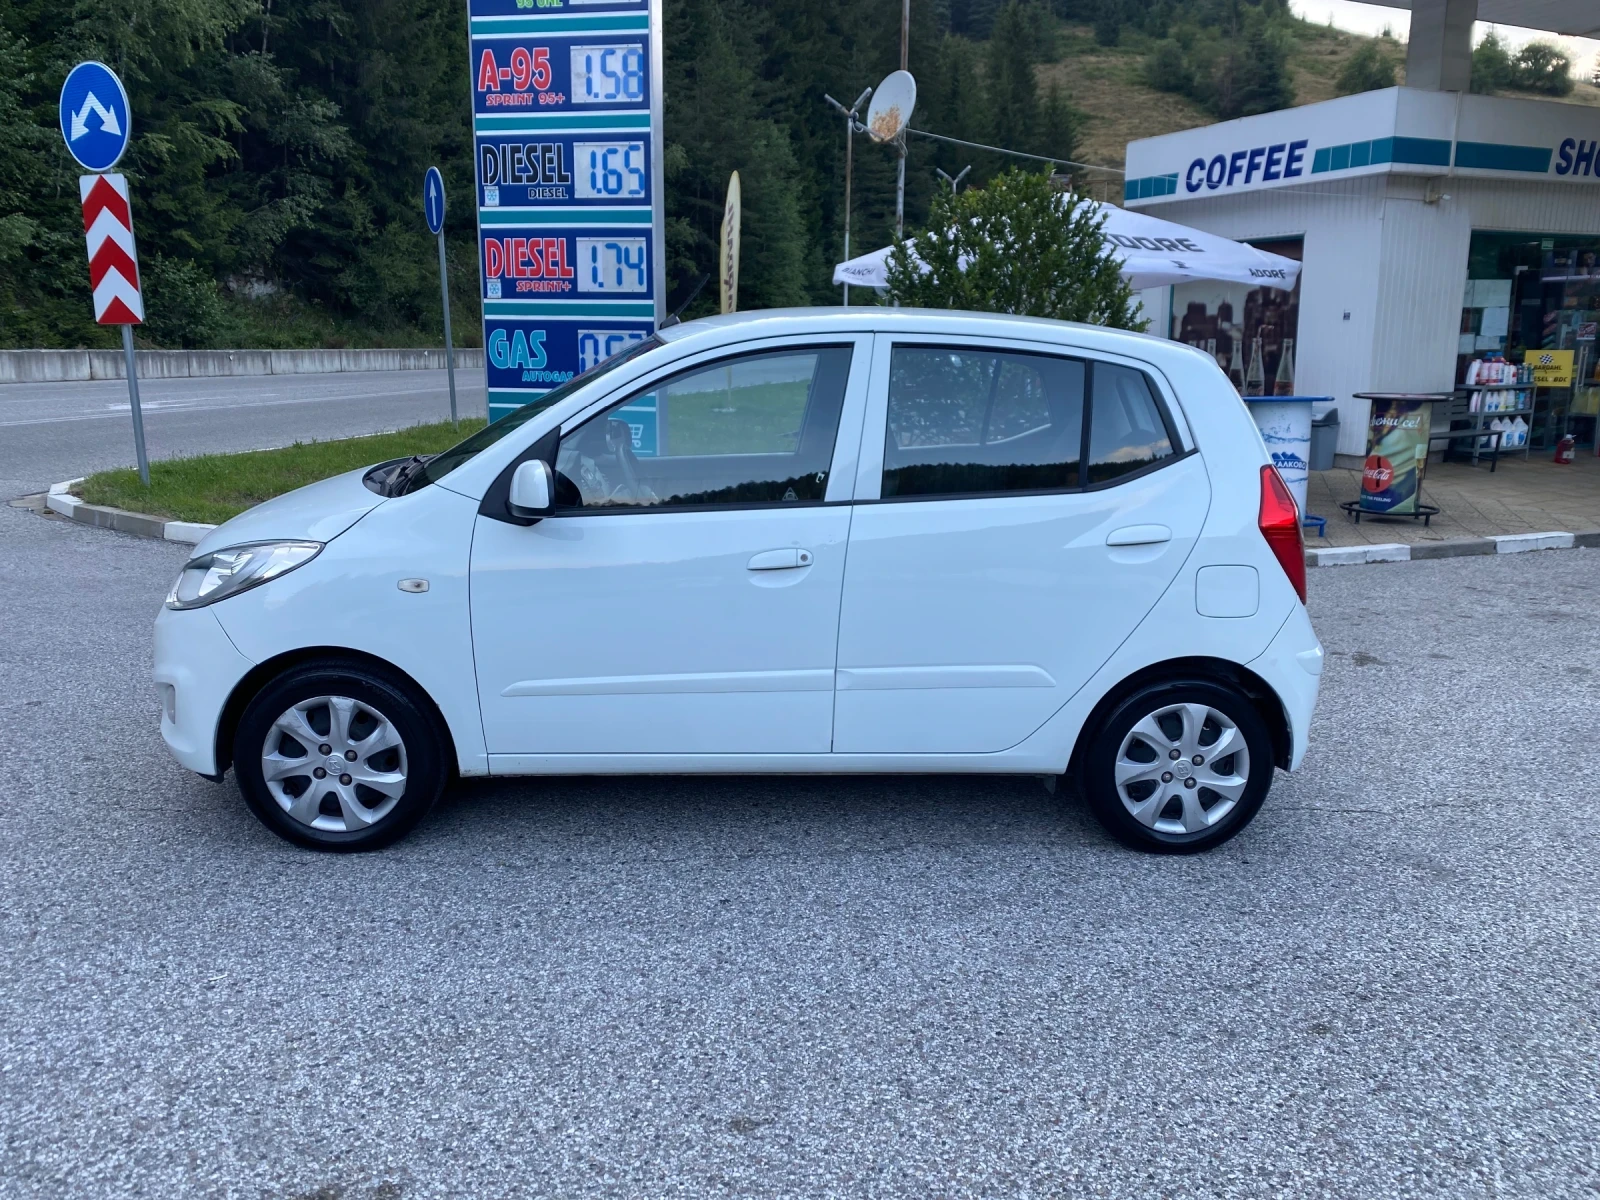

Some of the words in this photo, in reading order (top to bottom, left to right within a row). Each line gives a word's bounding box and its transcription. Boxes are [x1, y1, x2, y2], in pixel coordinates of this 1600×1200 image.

[478, 47, 552, 92] A-95
[585, 48, 643, 100] 1.58
[486, 93, 534, 106] SPRINT
[538, 92, 565, 105] 95+
[481, 143, 571, 186] DIESEL
[590, 144, 645, 195] 1.65
[1185, 139, 1309, 193] COFFEE
[528, 187, 569, 200] DIESEL
[485, 238, 574, 279] DIESEL
[591, 242, 644, 288] 1.74
[842, 267, 876, 276] BIANCHI
[516, 281, 572, 293] SPRINT+
[488, 328, 547, 369] GAS
[522, 371, 574, 383] AUTOGAS
